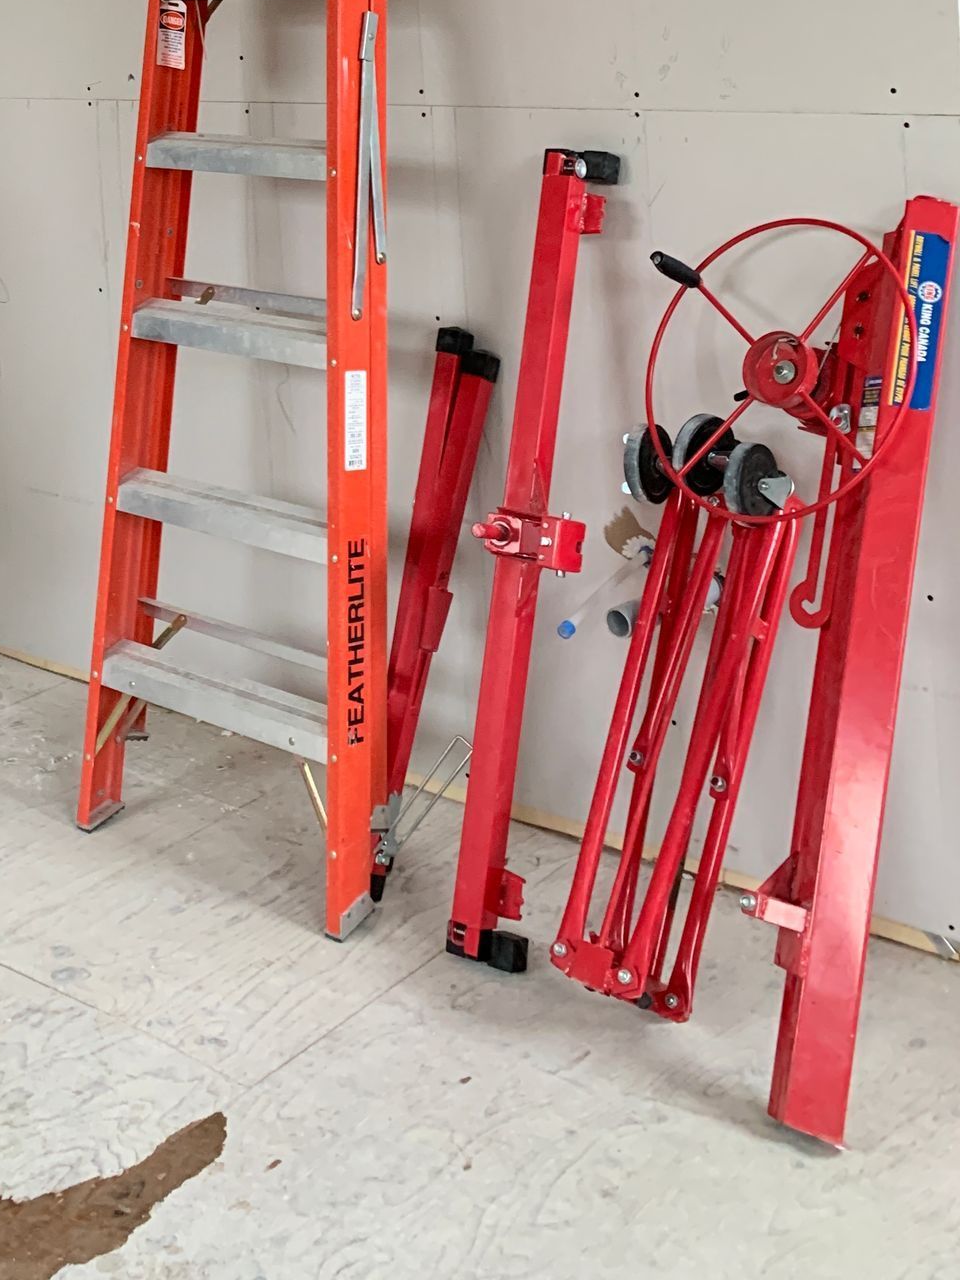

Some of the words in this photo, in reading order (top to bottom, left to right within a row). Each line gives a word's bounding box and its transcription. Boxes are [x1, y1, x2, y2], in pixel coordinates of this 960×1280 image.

[911, 262, 921, 277] PANEL
[910, 277, 919, 288] LIFT
[920, 303, 933, 326] KING
[916, 327, 931, 362] CANADA
[347, 538, 366, 747] FEATHERLITE
